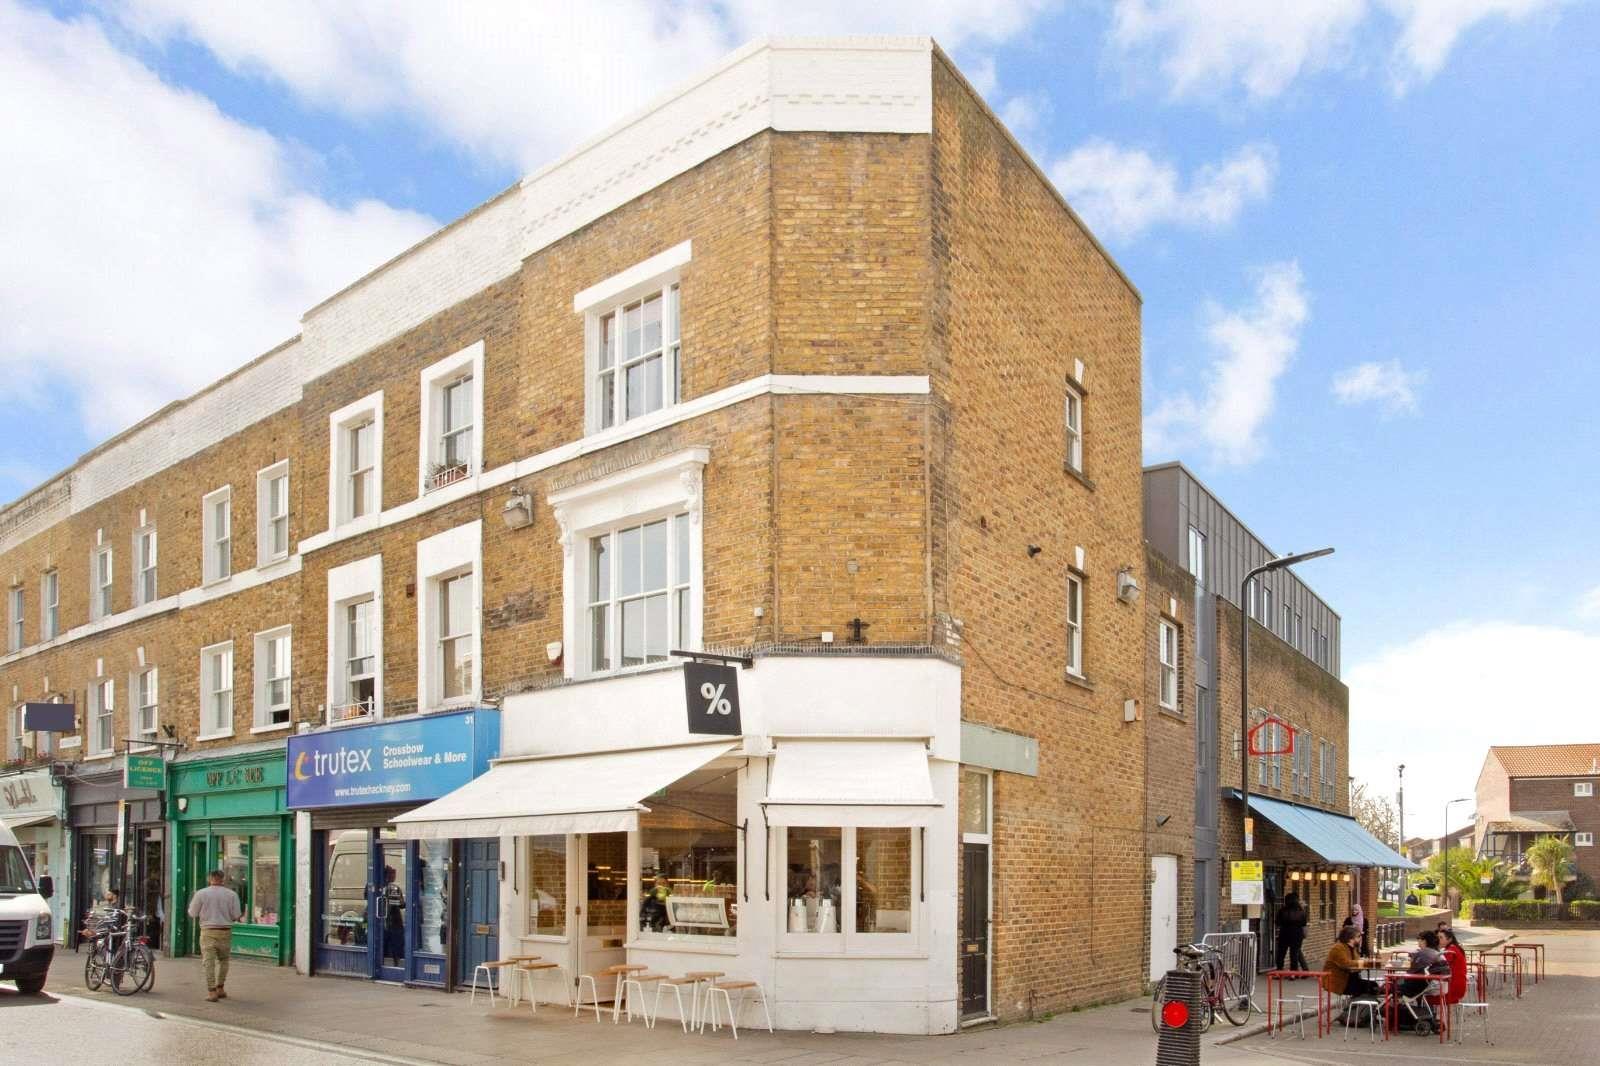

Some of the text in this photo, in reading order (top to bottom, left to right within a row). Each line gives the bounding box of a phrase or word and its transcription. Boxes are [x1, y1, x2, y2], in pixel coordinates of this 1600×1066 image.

[383, 743, 424, 756] Crossbow
[314, 747, 372, 777] trutex
[383, 751, 466, 770] Schoolwear & More
[334, 783, 411, 797] www.trutexhackney.com
